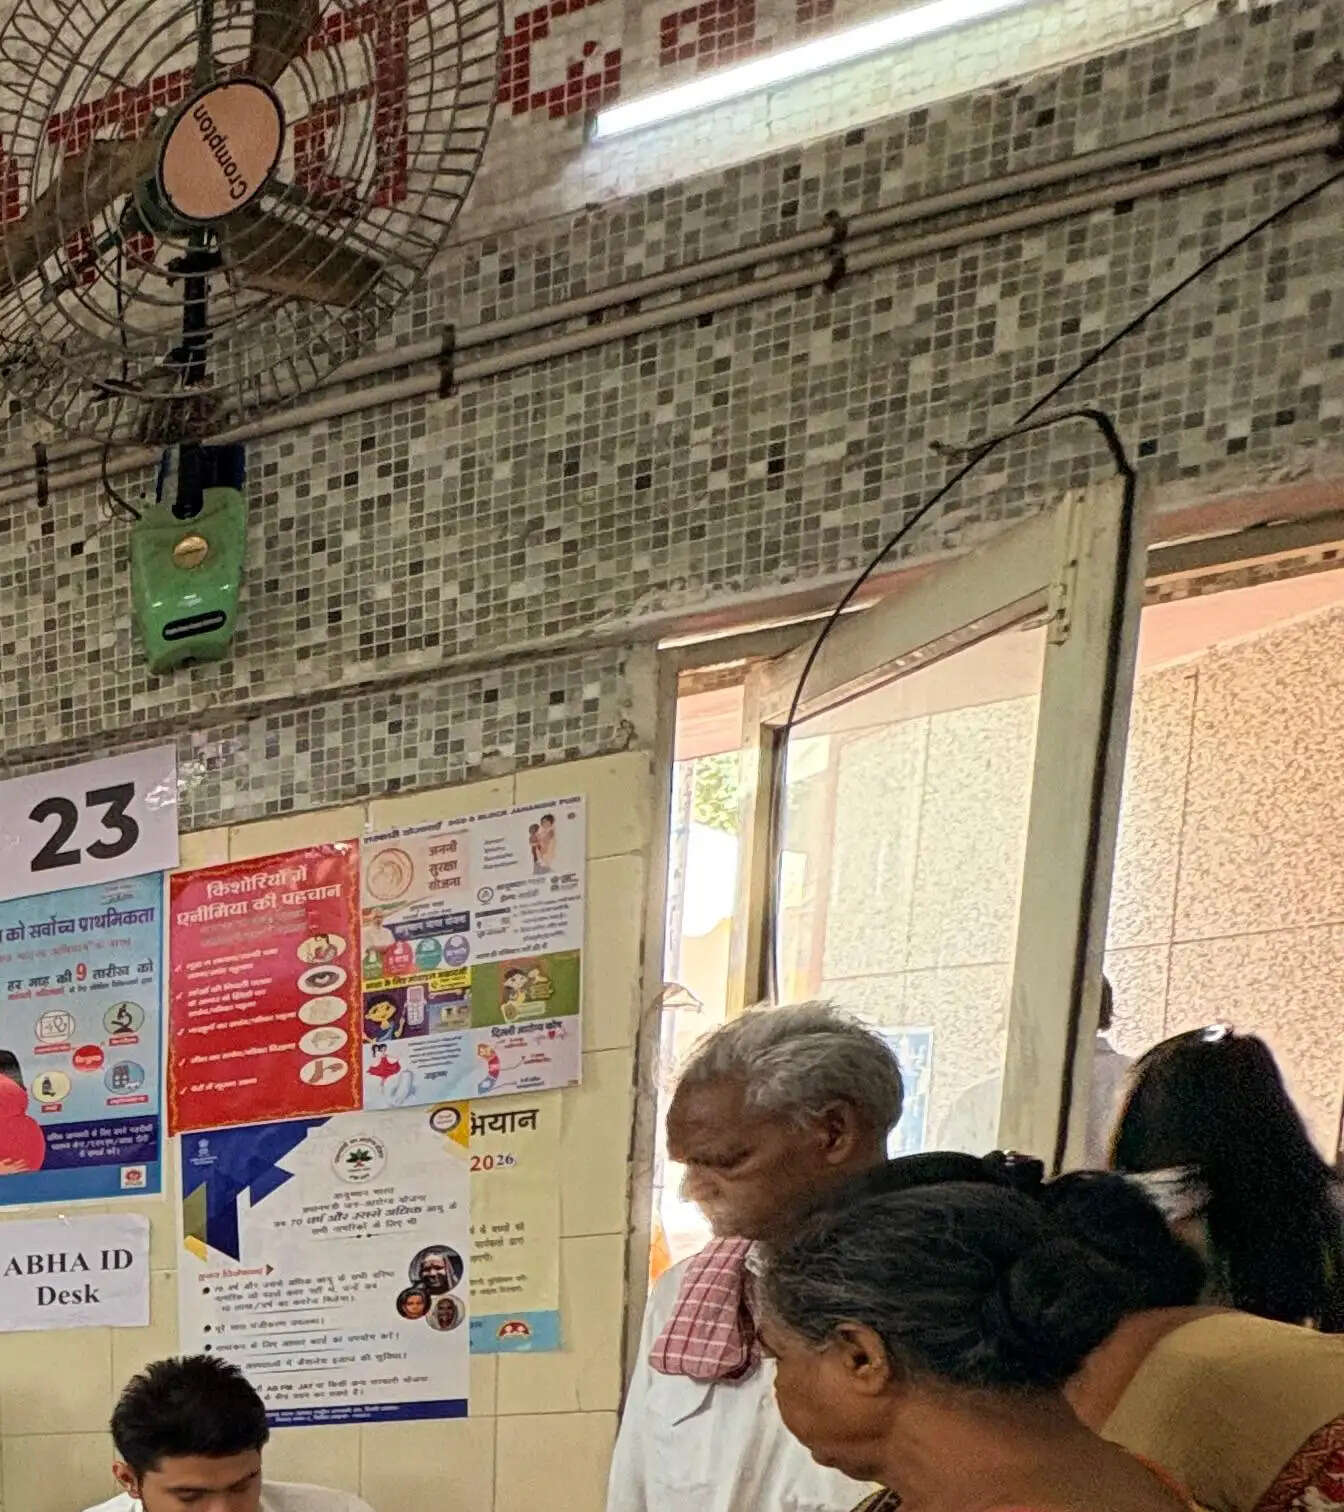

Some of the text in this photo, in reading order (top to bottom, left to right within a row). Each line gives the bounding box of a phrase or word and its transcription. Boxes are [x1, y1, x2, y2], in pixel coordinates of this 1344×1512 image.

[193, 103, 249, 200] Crompton
[28, 782, 139, 872] 23
[429, 840, 457, 856] जननी
[207, 868, 288, 898] किशोरियों
[428, 876, 460, 890] योजना
[429, 860, 457, 876] सुरक्षा
[177, 883, 342, 926] एनीमिया की पहचान
[6, 920, 25, 941] को
[30, 916, 75, 937] सर्वोच्च
[78, 907, 155, 932] प्राथमिकता
[8, 979, 22, 992] हर
[57, 969, 72, 984] की
[75, 963, 87, 982] 9
[93, 965, 129, 980] तारीख
[137, 958, 153, 974] को
[3, 1248, 133, 1277] ABHA ID
[37, 1284, 101, 1306] Desk
